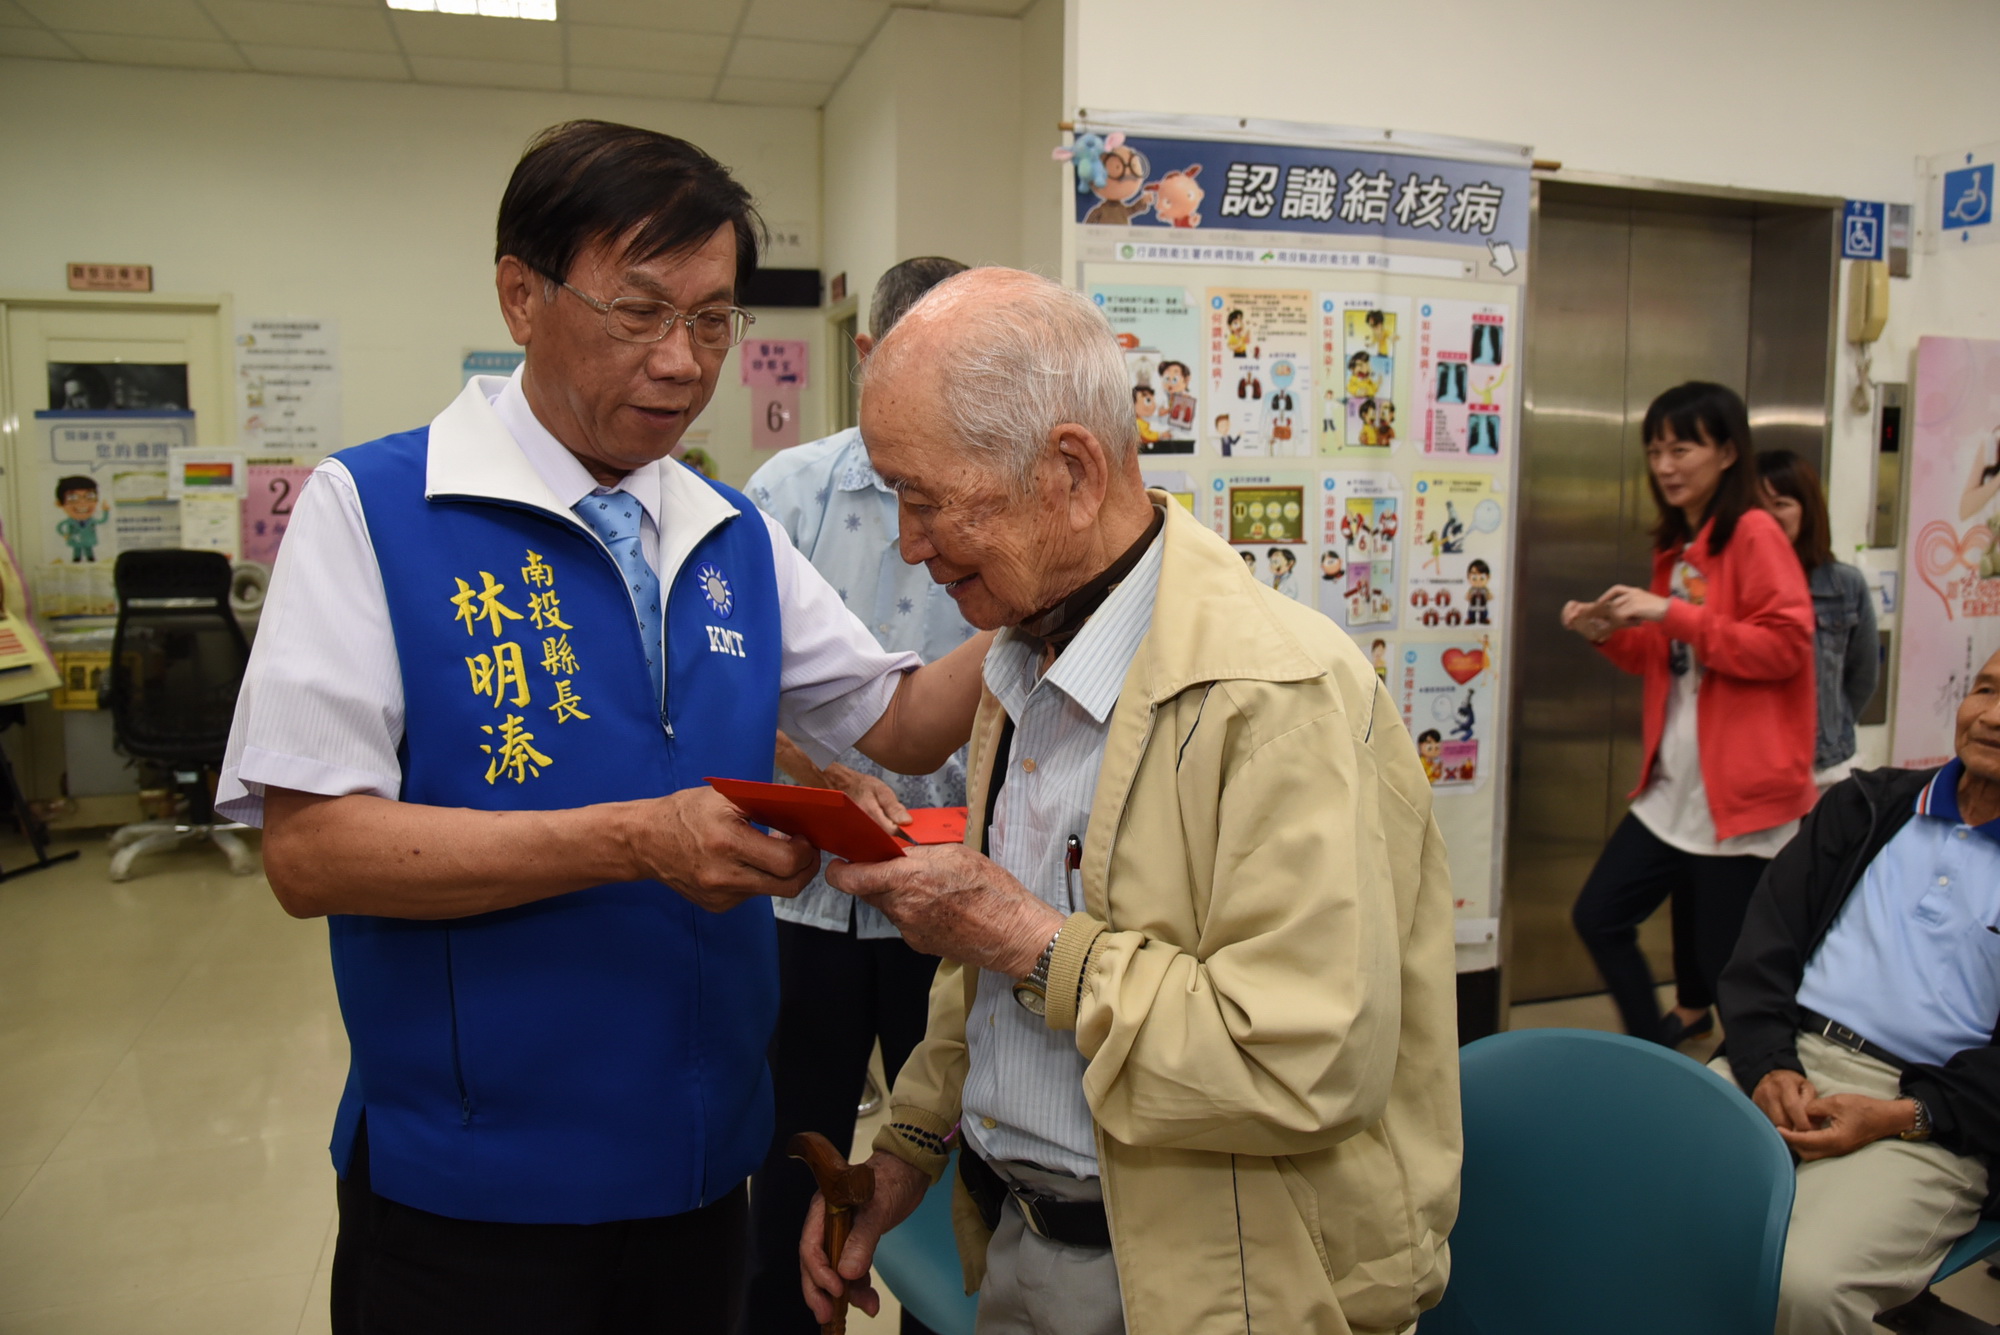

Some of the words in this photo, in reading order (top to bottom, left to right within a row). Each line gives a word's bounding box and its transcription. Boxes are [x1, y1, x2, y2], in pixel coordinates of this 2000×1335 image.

[1220, 162, 1504, 235] 認識結核病
[766, 400, 784, 433] 6
[269, 477, 291, 515] 2
[520, 548, 592, 725] 南投縣長
[705, 625, 746, 658] KMT
[449, 570, 554, 785] 林明溱
